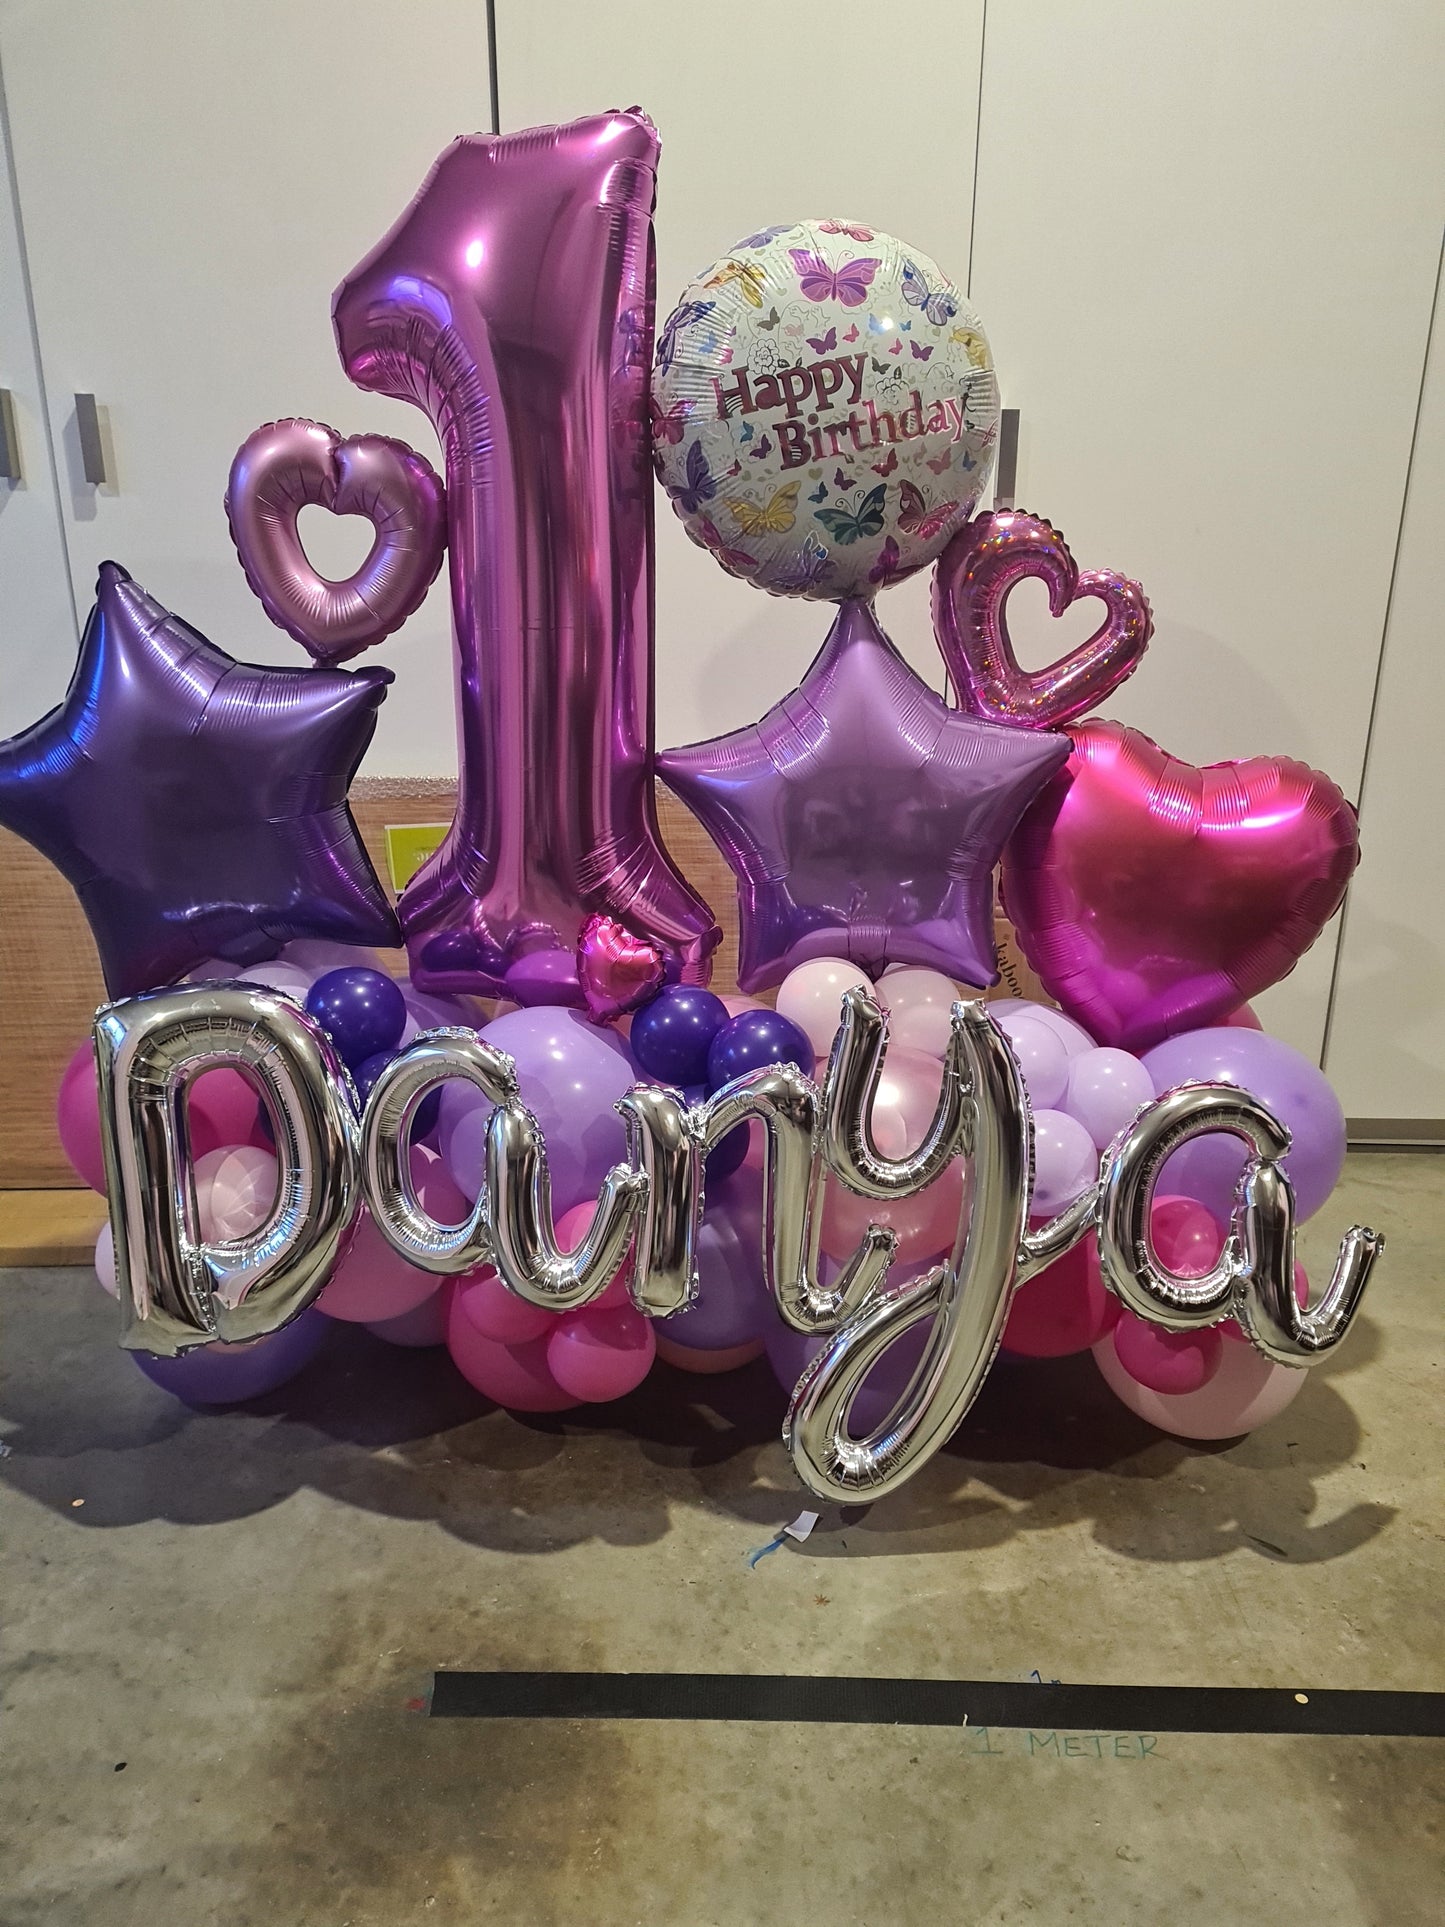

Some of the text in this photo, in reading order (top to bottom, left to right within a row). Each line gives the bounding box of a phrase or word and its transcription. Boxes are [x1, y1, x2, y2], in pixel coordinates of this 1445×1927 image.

[710, 351, 868, 421] Happy
[772, 389, 967, 471] Birthday
[996, 942, 1026, 999] kaboo
[94, 977, 1386, 1506] Danya
[970, 1726, 1169, 1761] 1 METER
